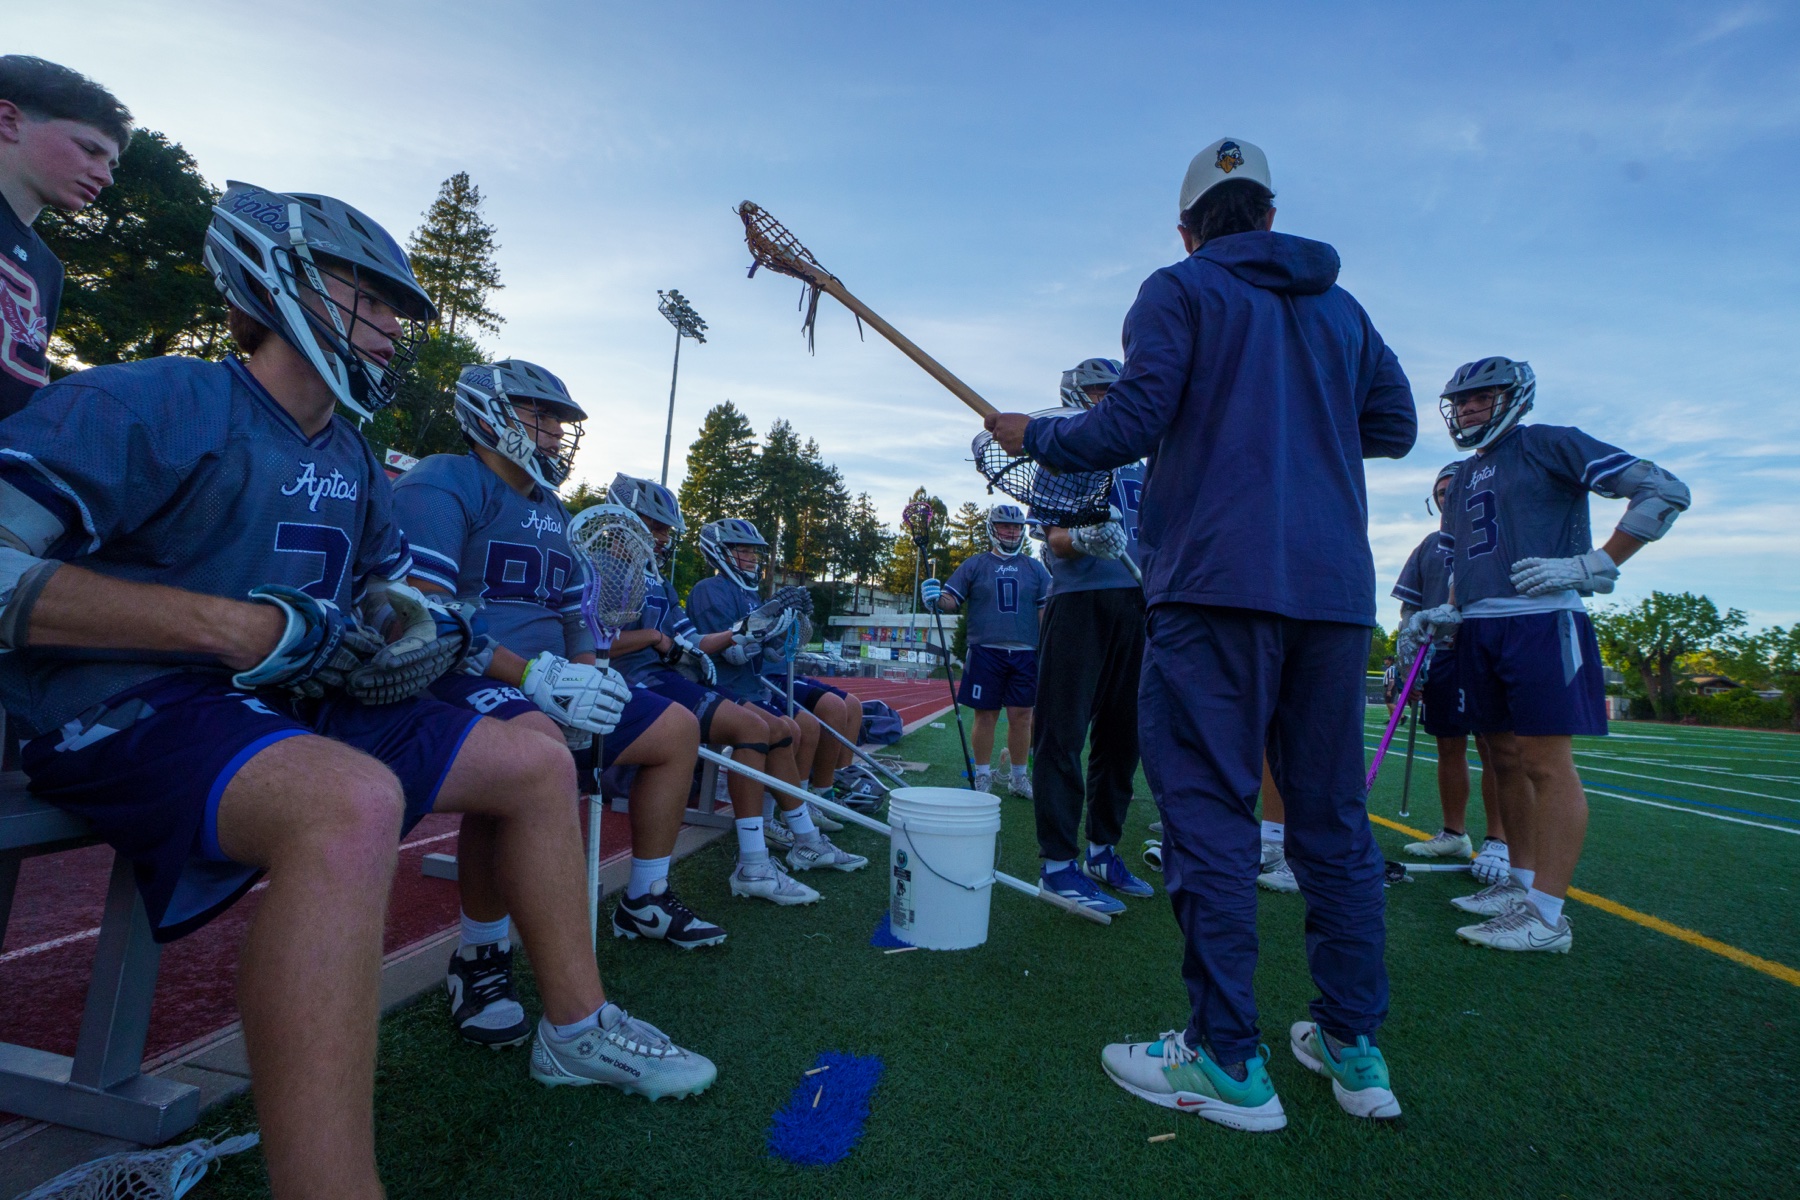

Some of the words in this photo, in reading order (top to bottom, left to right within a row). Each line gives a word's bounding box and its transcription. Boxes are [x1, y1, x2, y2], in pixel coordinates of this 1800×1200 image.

[221, 189, 290, 234] Aptos
[281, 460, 358, 512] Aptos
[1465, 465, 1496, 491] Aptos
[521, 509, 562, 539] Aptos
[1466, 490, 1499, 560] 3
[995, 564, 1019, 575] Aptos
[996, 577, 1020, 614] 0
[544, 656, 568, 686] STX
[972, 684, 982, 699] 0
[1458, 688, 1465, 713] 3
[599, 1054, 614, 1065] new
[614, 1059, 641, 1078] balance
